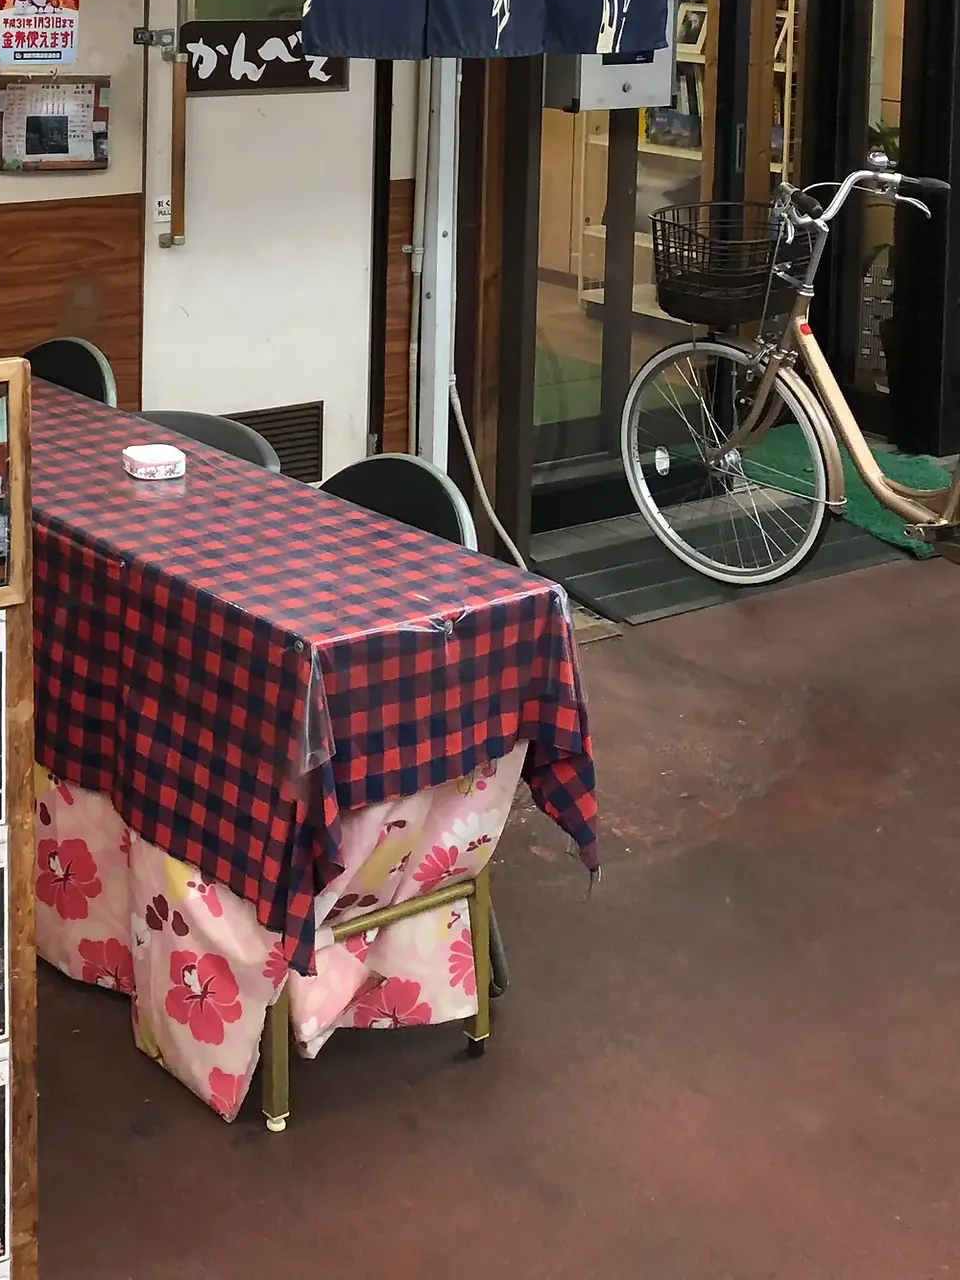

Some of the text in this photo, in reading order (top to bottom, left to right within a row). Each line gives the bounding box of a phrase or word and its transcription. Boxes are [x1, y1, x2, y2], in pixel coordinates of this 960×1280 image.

[2, 17, 74, 28] 平成31年1月31日まで
[2, 31, 74, 49] 金券使えます!
[185, 31, 333, 83] かんべえ
